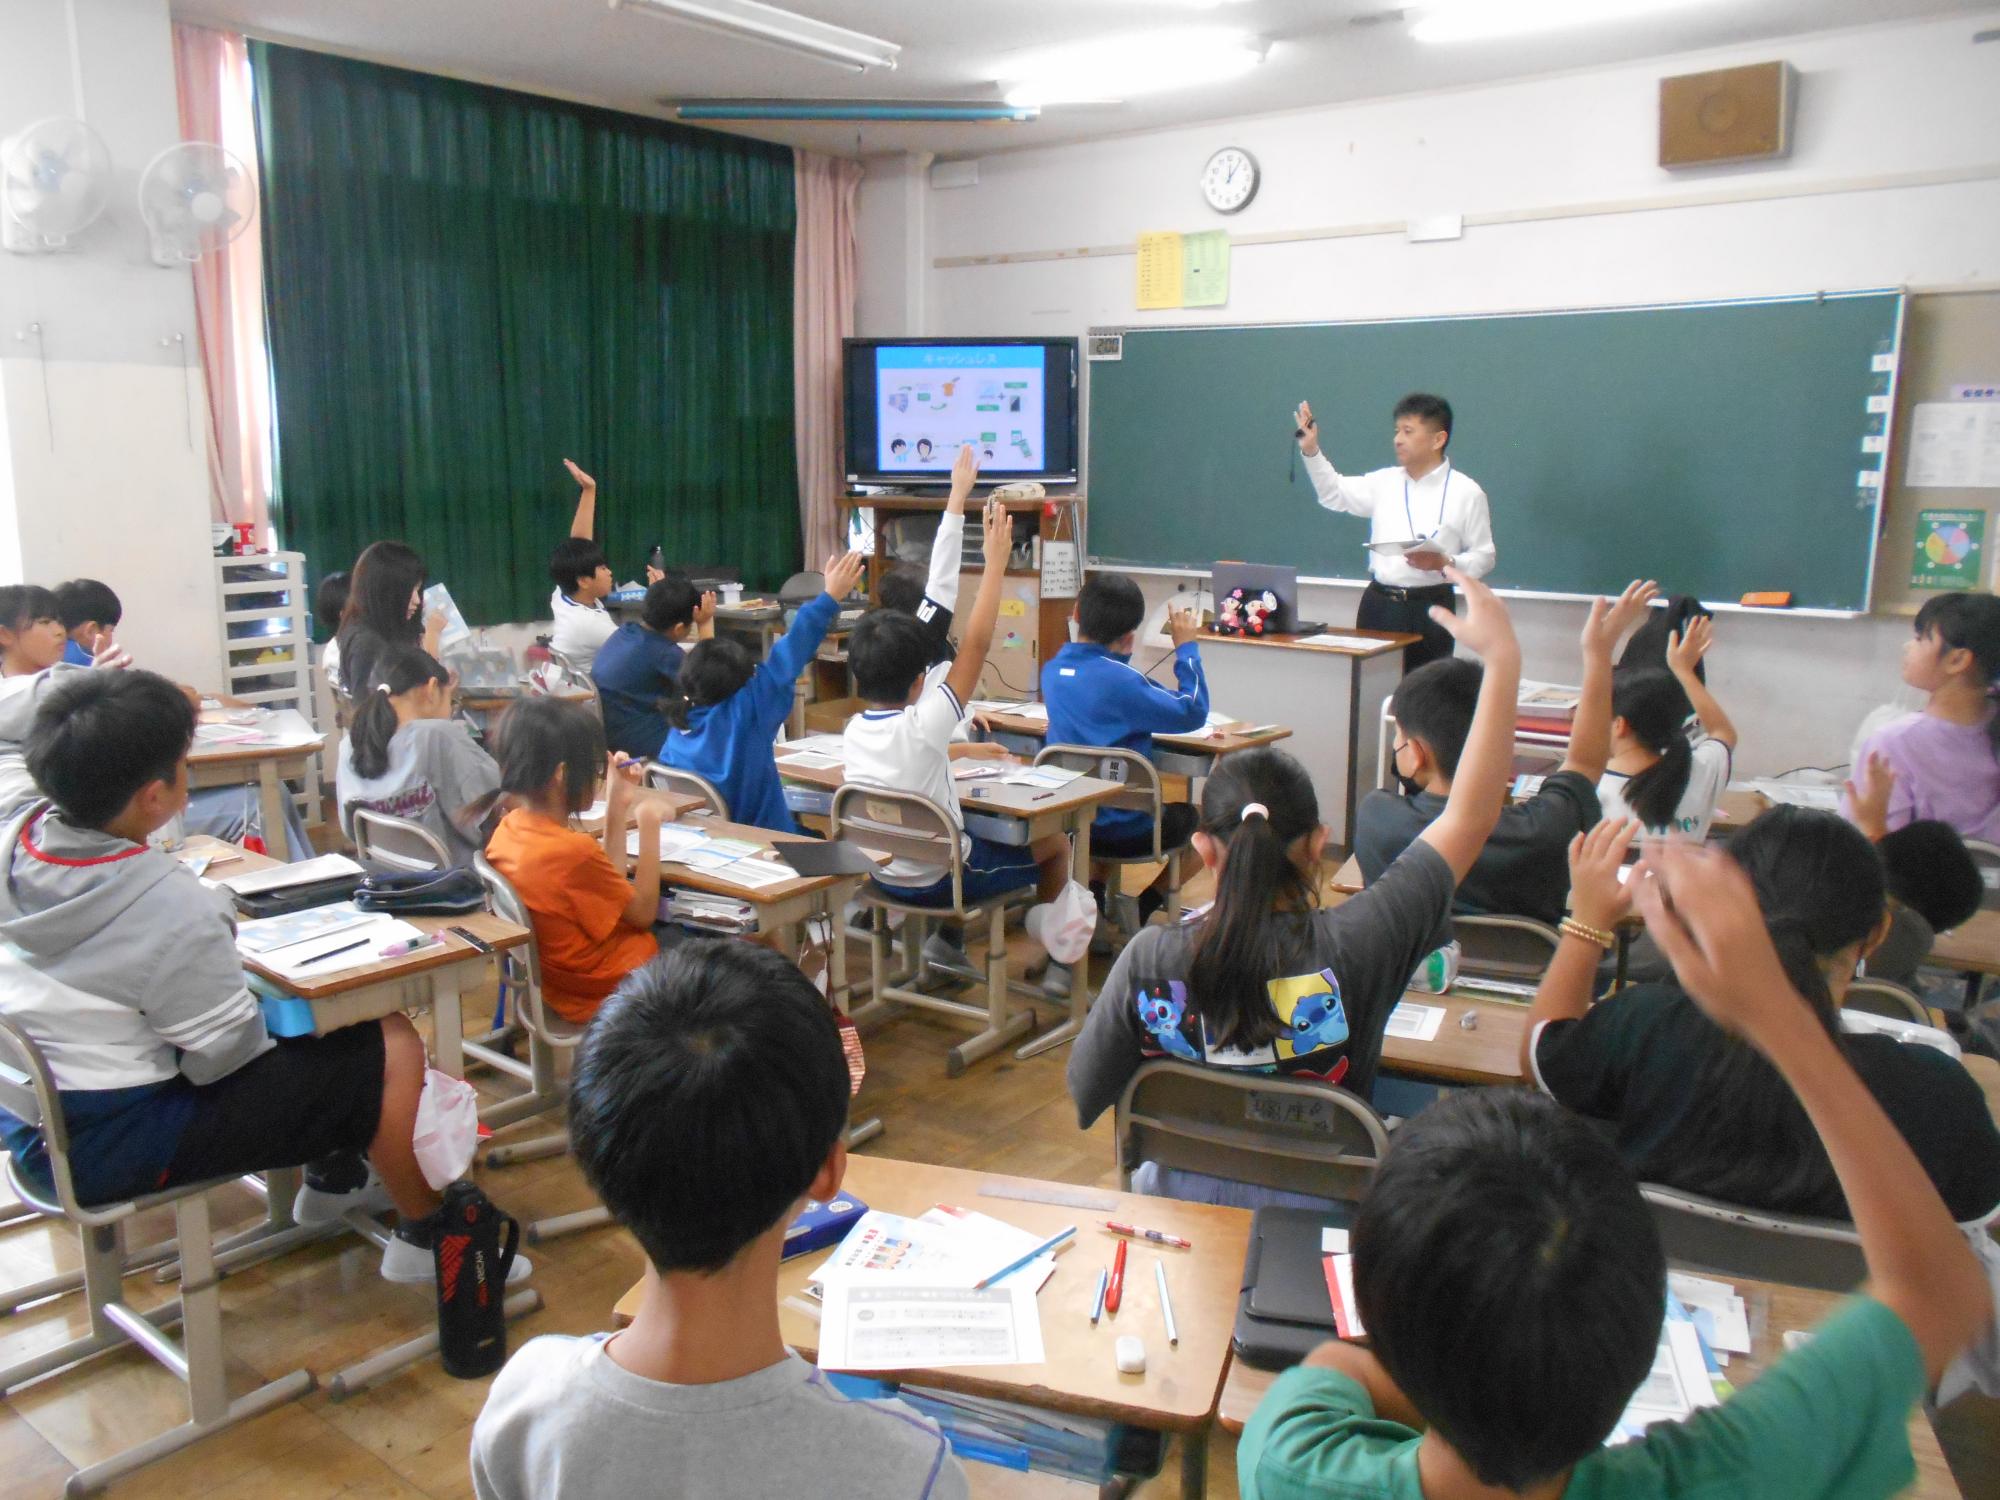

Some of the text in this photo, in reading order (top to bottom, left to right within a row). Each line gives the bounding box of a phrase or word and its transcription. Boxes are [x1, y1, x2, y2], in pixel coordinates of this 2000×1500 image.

[924, 353, 997, 365] キャッシュレス
